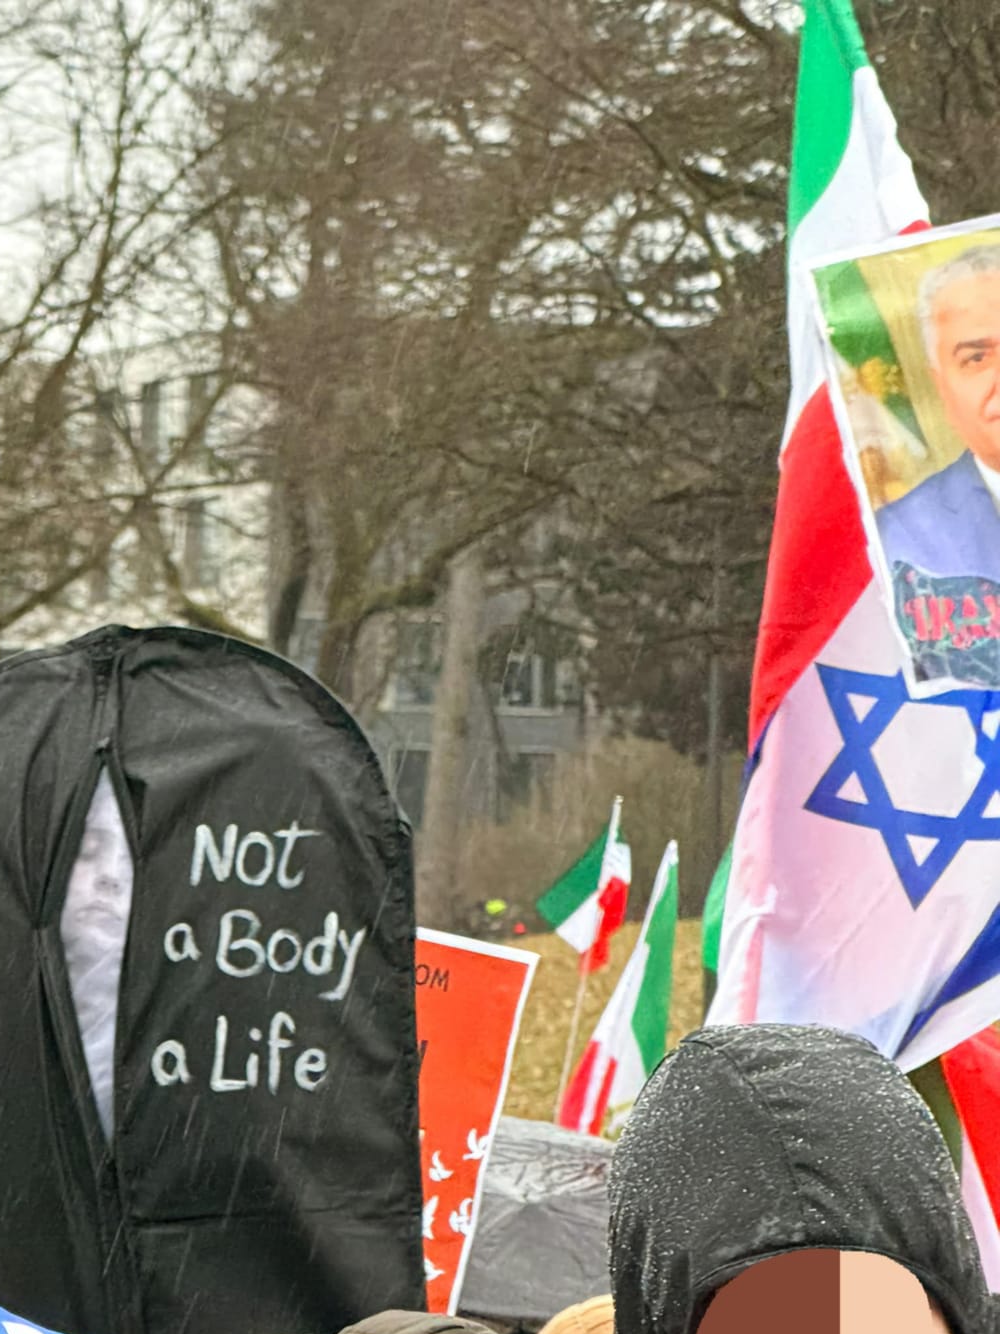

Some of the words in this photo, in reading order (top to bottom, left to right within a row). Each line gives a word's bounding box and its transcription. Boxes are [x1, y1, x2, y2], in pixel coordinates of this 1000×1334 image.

[190, 820, 324, 890] Not
[163, 922, 202, 962] a
[215, 908, 367, 1001] Body
[151, 1039, 192, 1086] a
[209, 1011, 326, 1096] Life
